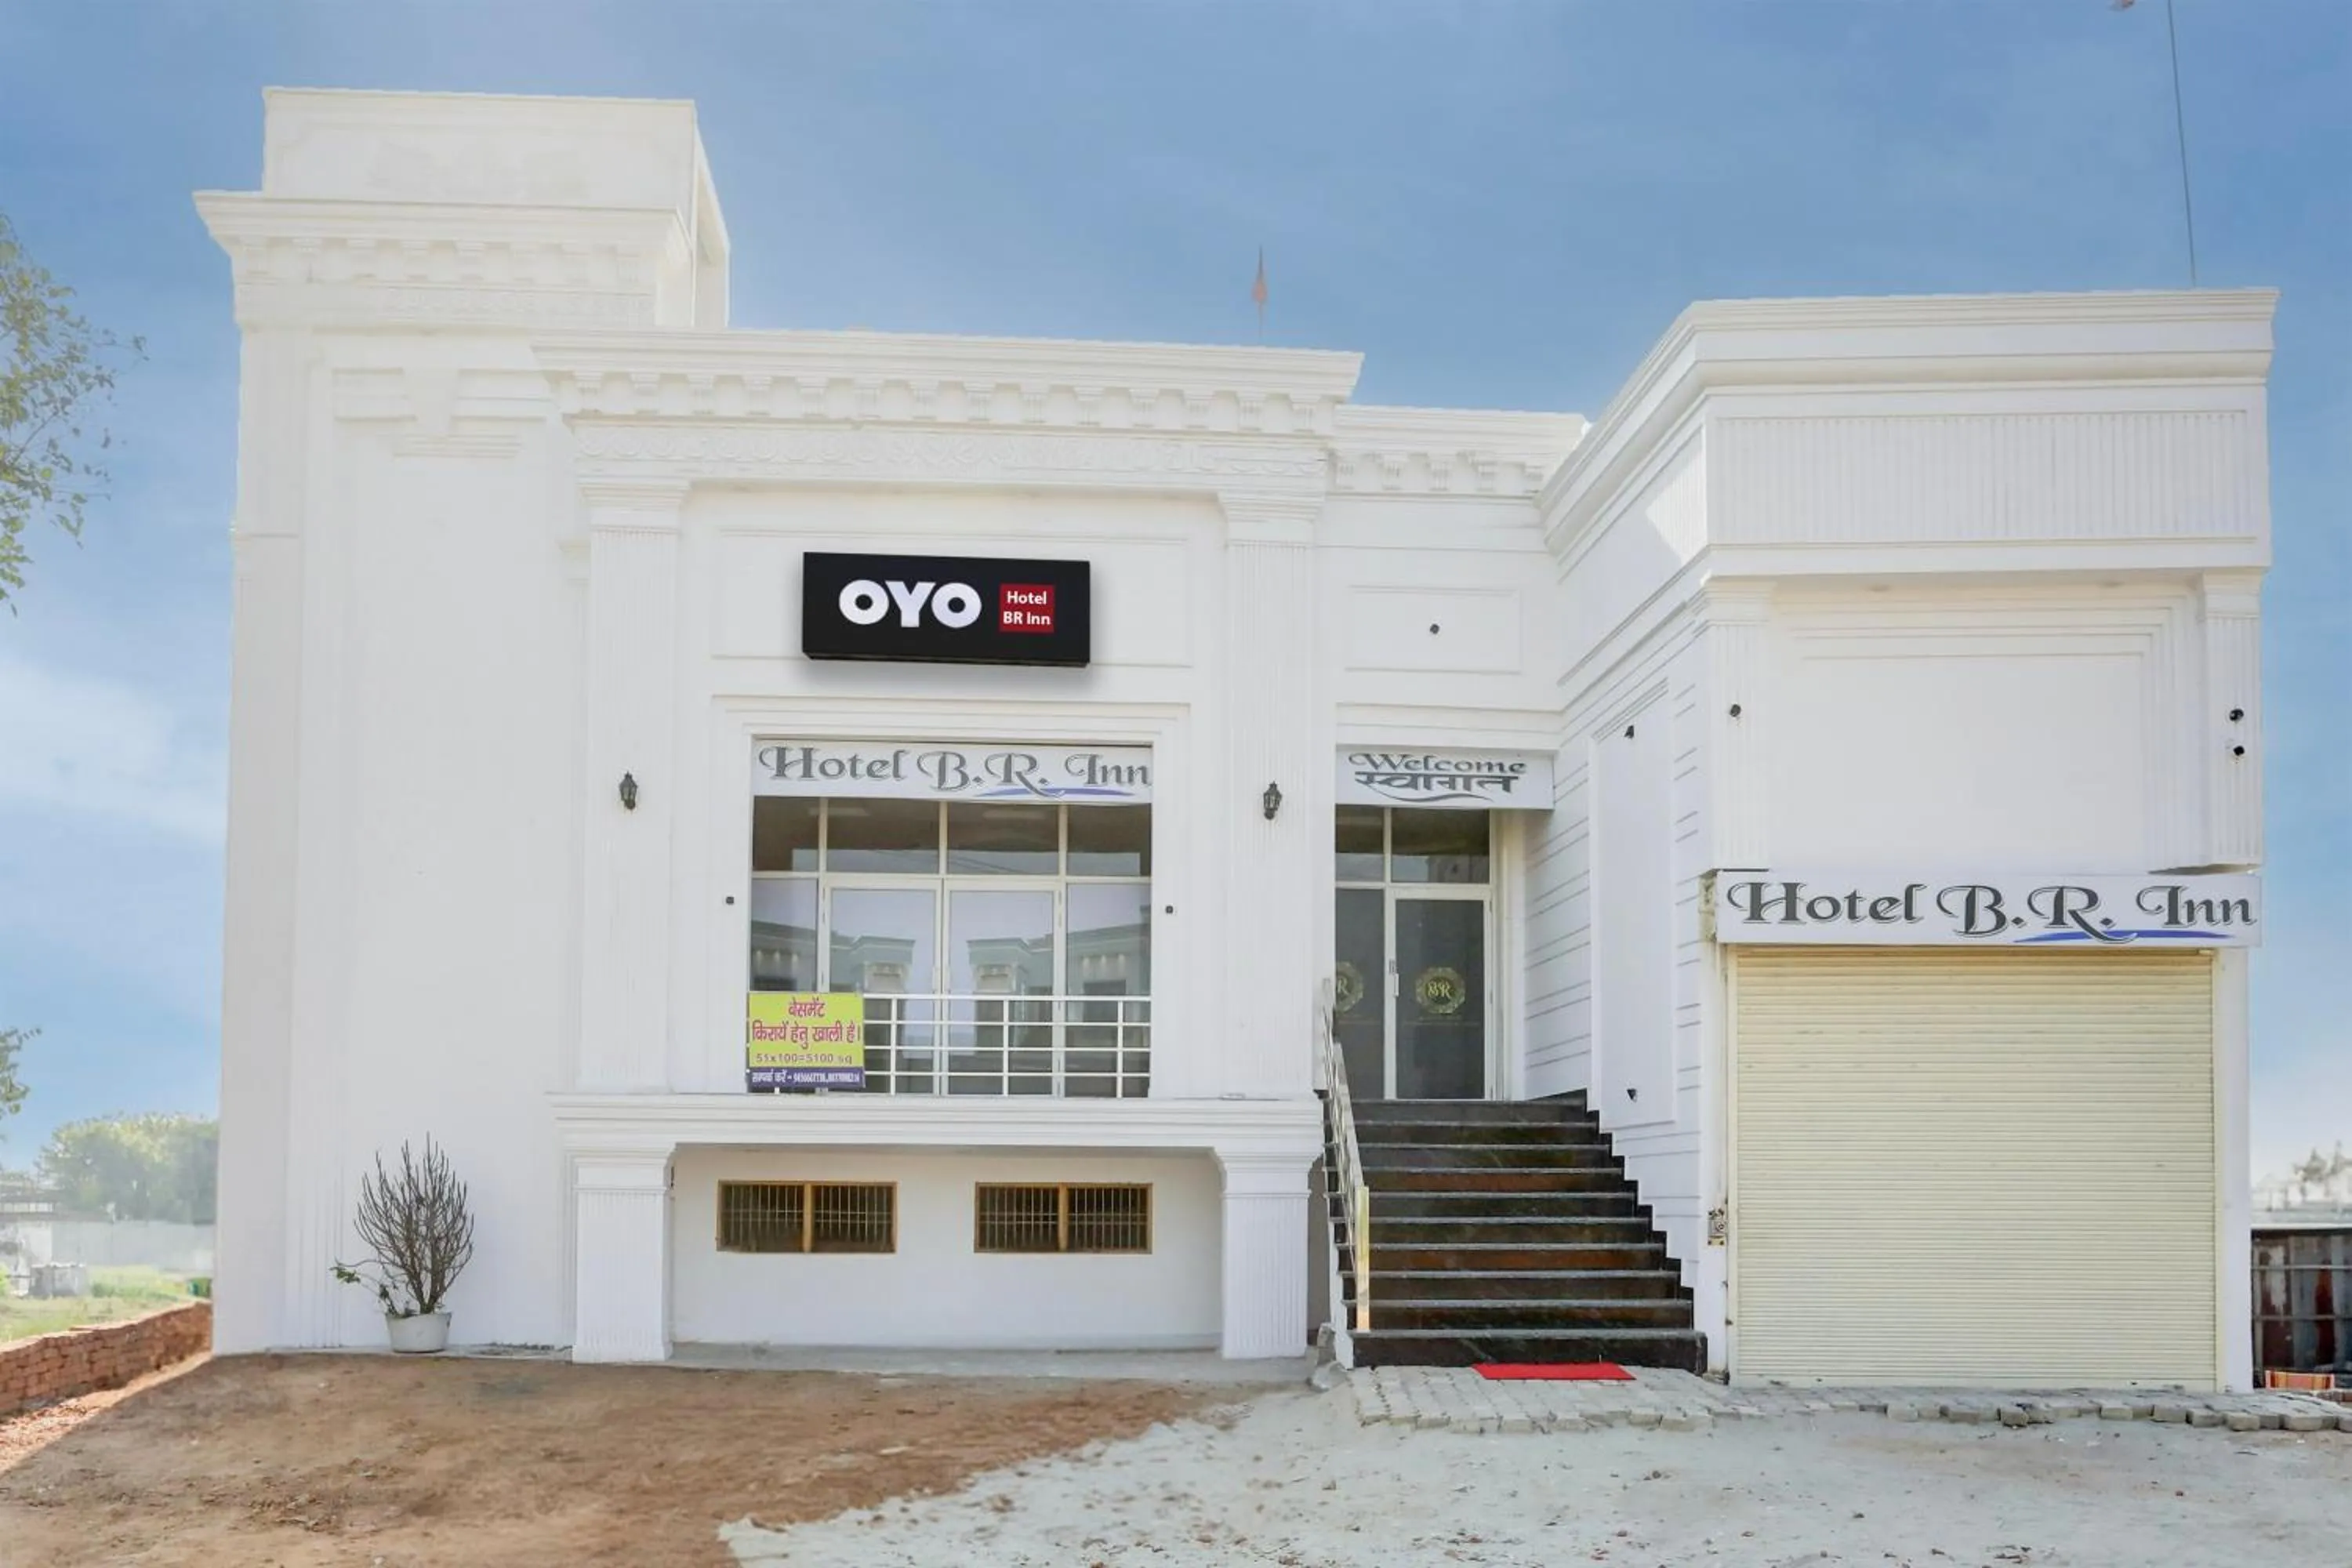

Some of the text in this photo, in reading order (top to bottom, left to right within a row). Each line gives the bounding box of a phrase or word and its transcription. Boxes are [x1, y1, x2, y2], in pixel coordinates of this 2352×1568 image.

[838, 579, 982, 629] OYO
[1007, 590, 1047, 604] Hotel
[1003, 611, 1051, 625] BR Inn
[758, 746, 912, 782] Hotel
[1064, 753, 1152, 787] Inn
[1348, 753, 1527, 775] Welcome
[1726, 881, 1928, 924] Hotel
[2135, 885, 2258, 928] Inn
[812, 1019, 843, 1042] खाली
